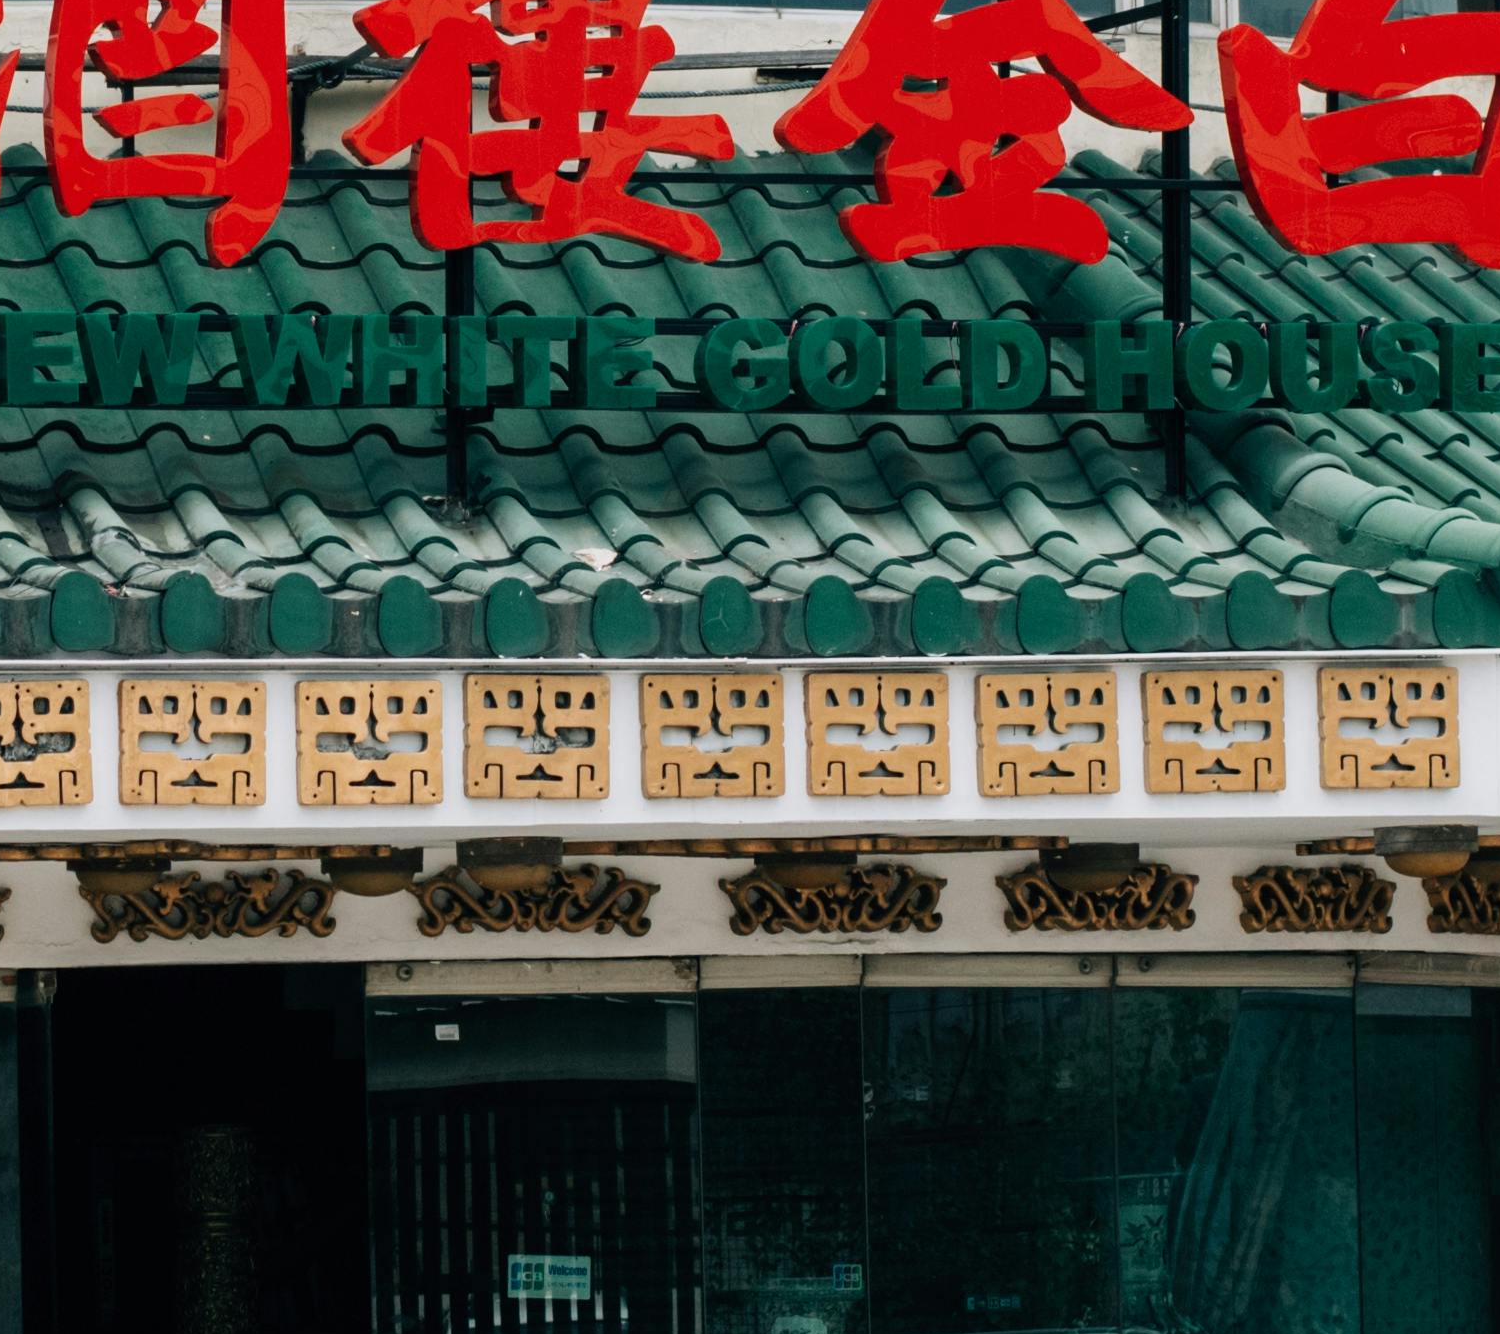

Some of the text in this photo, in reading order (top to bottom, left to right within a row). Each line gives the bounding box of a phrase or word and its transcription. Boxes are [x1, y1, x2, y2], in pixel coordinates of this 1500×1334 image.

[231, 313, 657, 408] WHITE
[694, 316, 1048, 411] GOLD
[547, 1264, 588, 1276] Welcome
